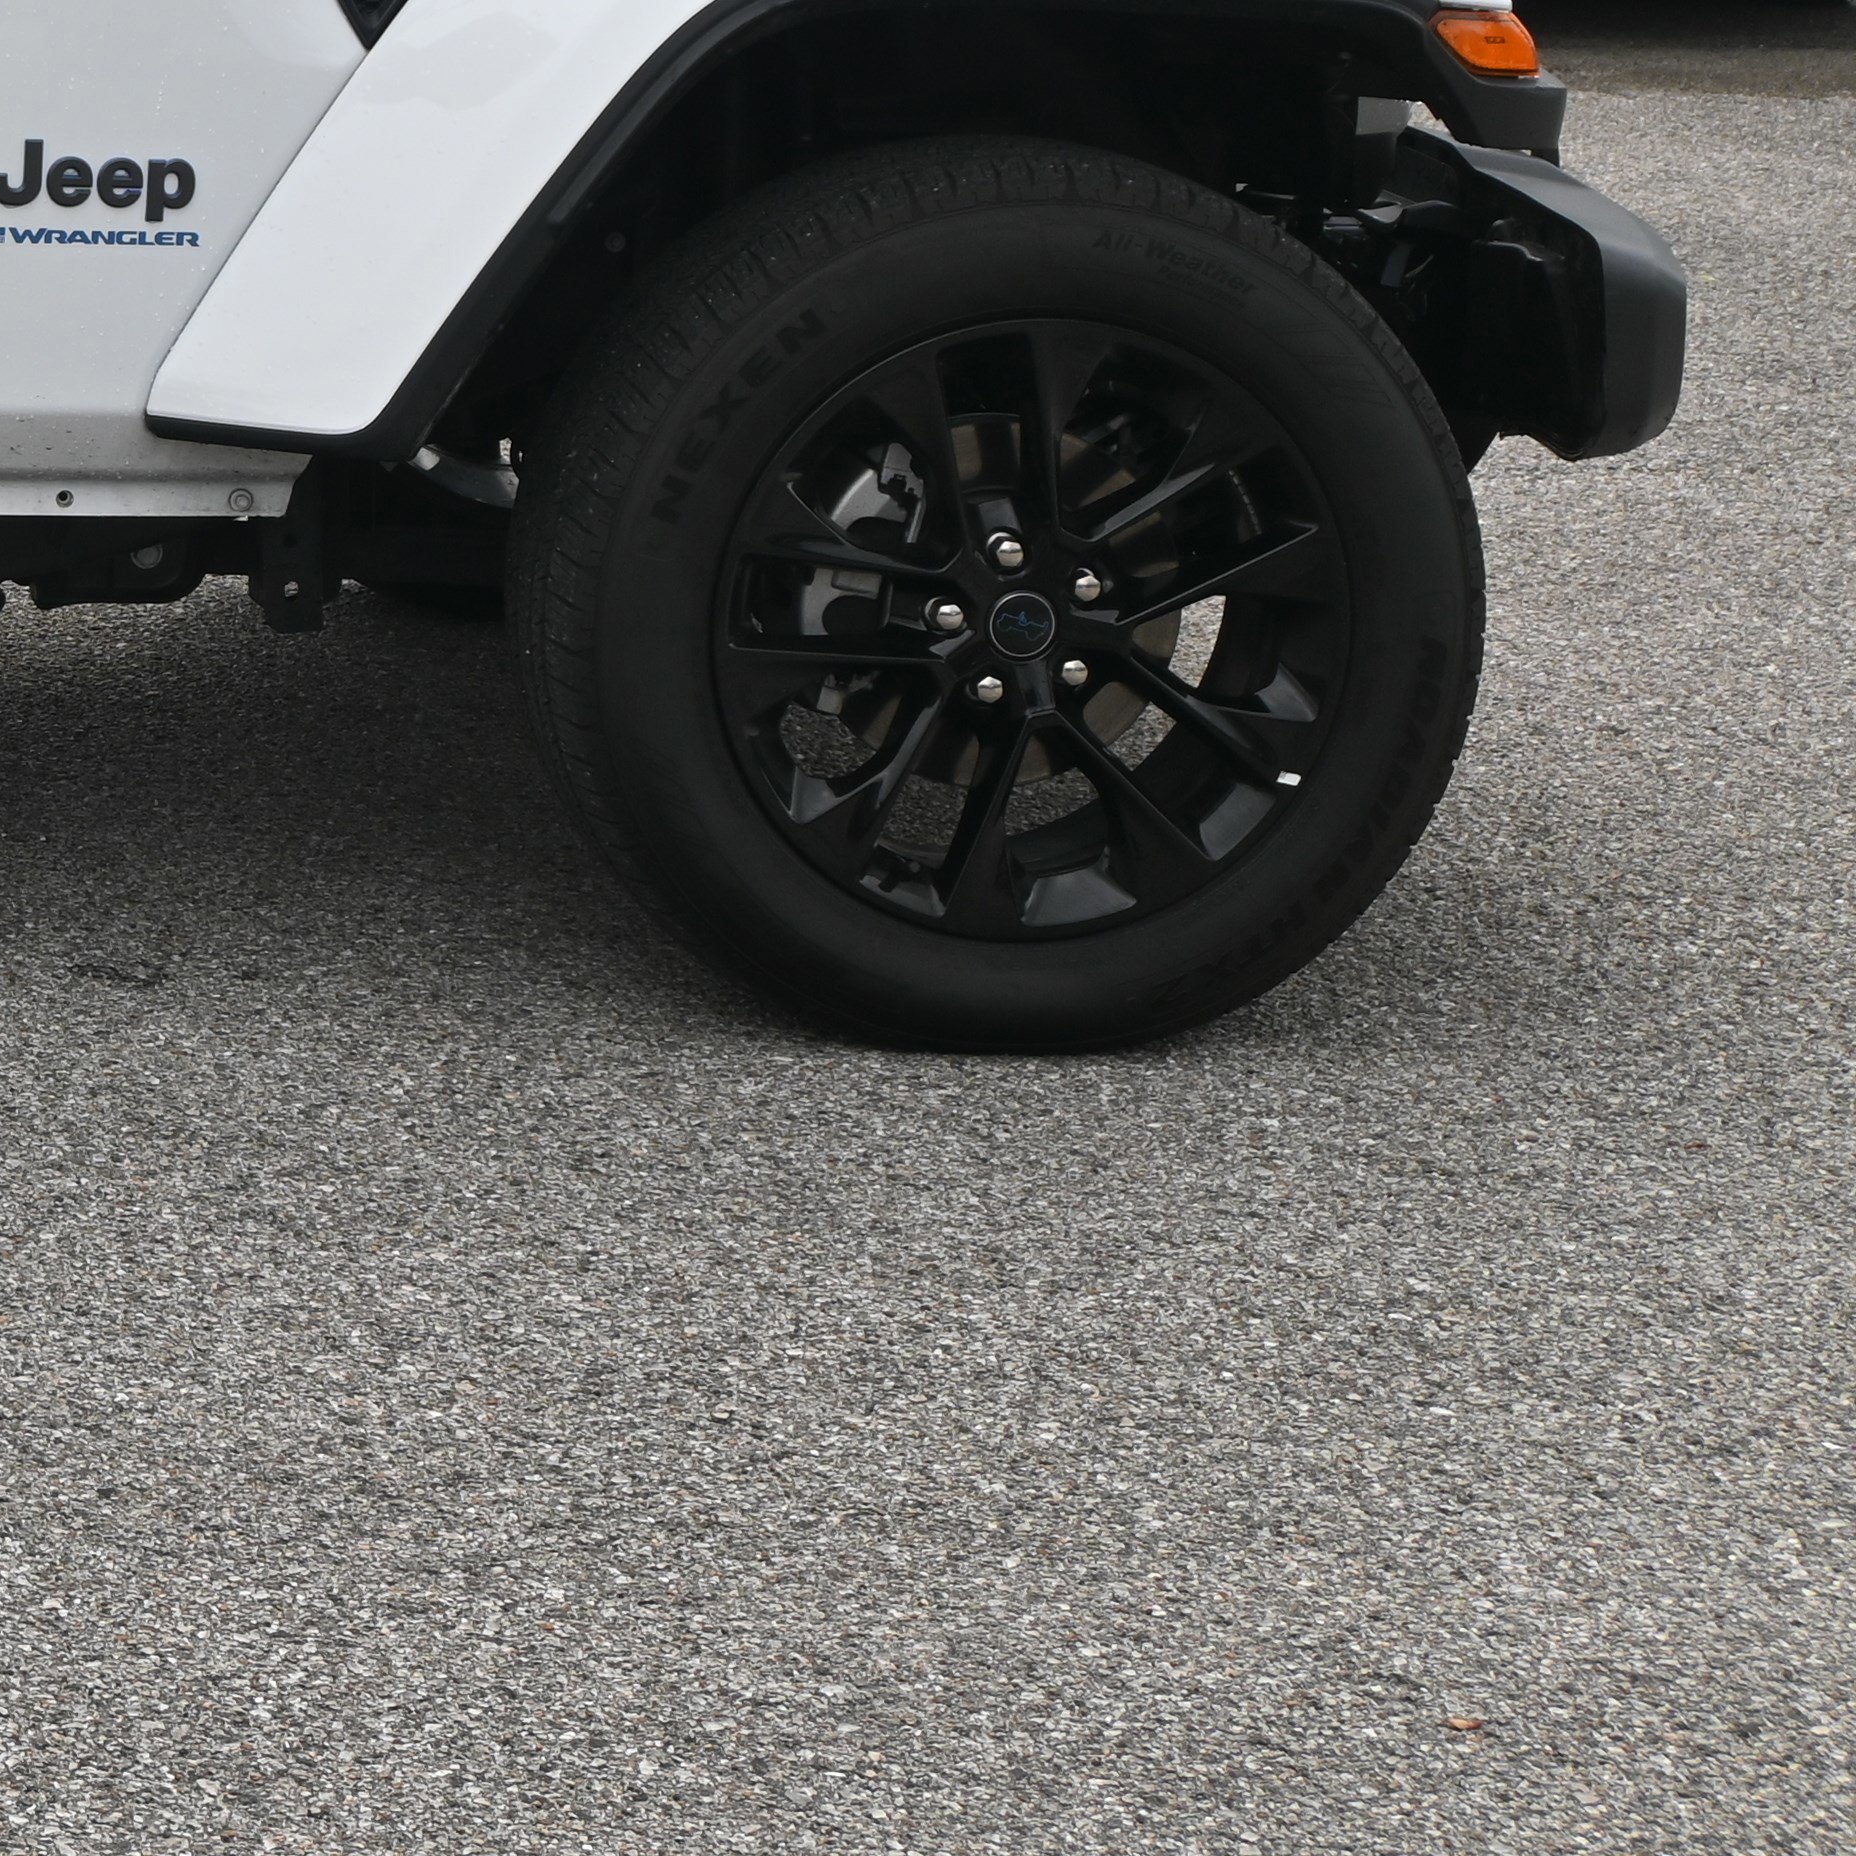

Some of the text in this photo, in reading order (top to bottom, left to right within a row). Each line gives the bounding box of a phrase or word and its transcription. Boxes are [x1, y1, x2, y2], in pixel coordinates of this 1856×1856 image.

[8, 226, 200, 248] WRANGLER
[1091, 229, 1258, 294] All-Weather
[649, 307, 829, 525] NEXEN
